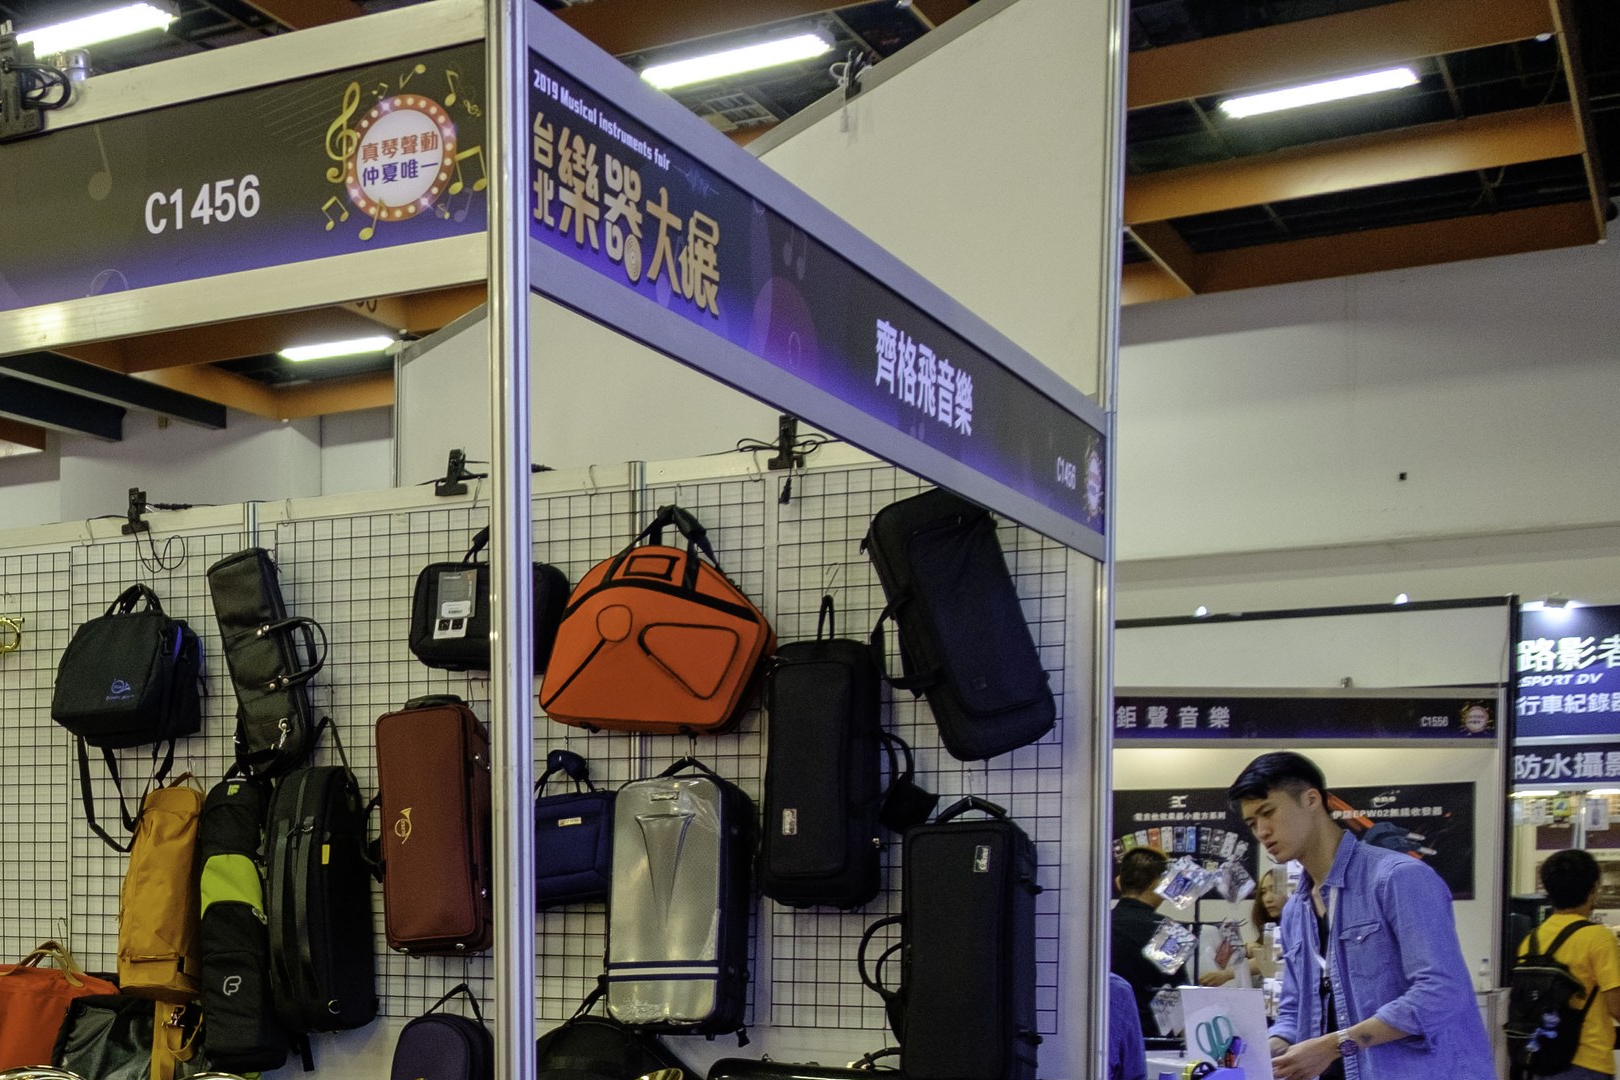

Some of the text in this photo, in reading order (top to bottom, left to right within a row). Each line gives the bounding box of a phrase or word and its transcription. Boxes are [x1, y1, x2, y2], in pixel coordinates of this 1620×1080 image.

[533, 69, 671, 172] 2019 Musical instruments fair
[361, 159, 440, 188] 仲夏唯一
[144, 174, 261, 235] C1456
[875, 318, 974, 437] 齊格飛音樂
[1518, 672, 1604, 688] SPORT DV
